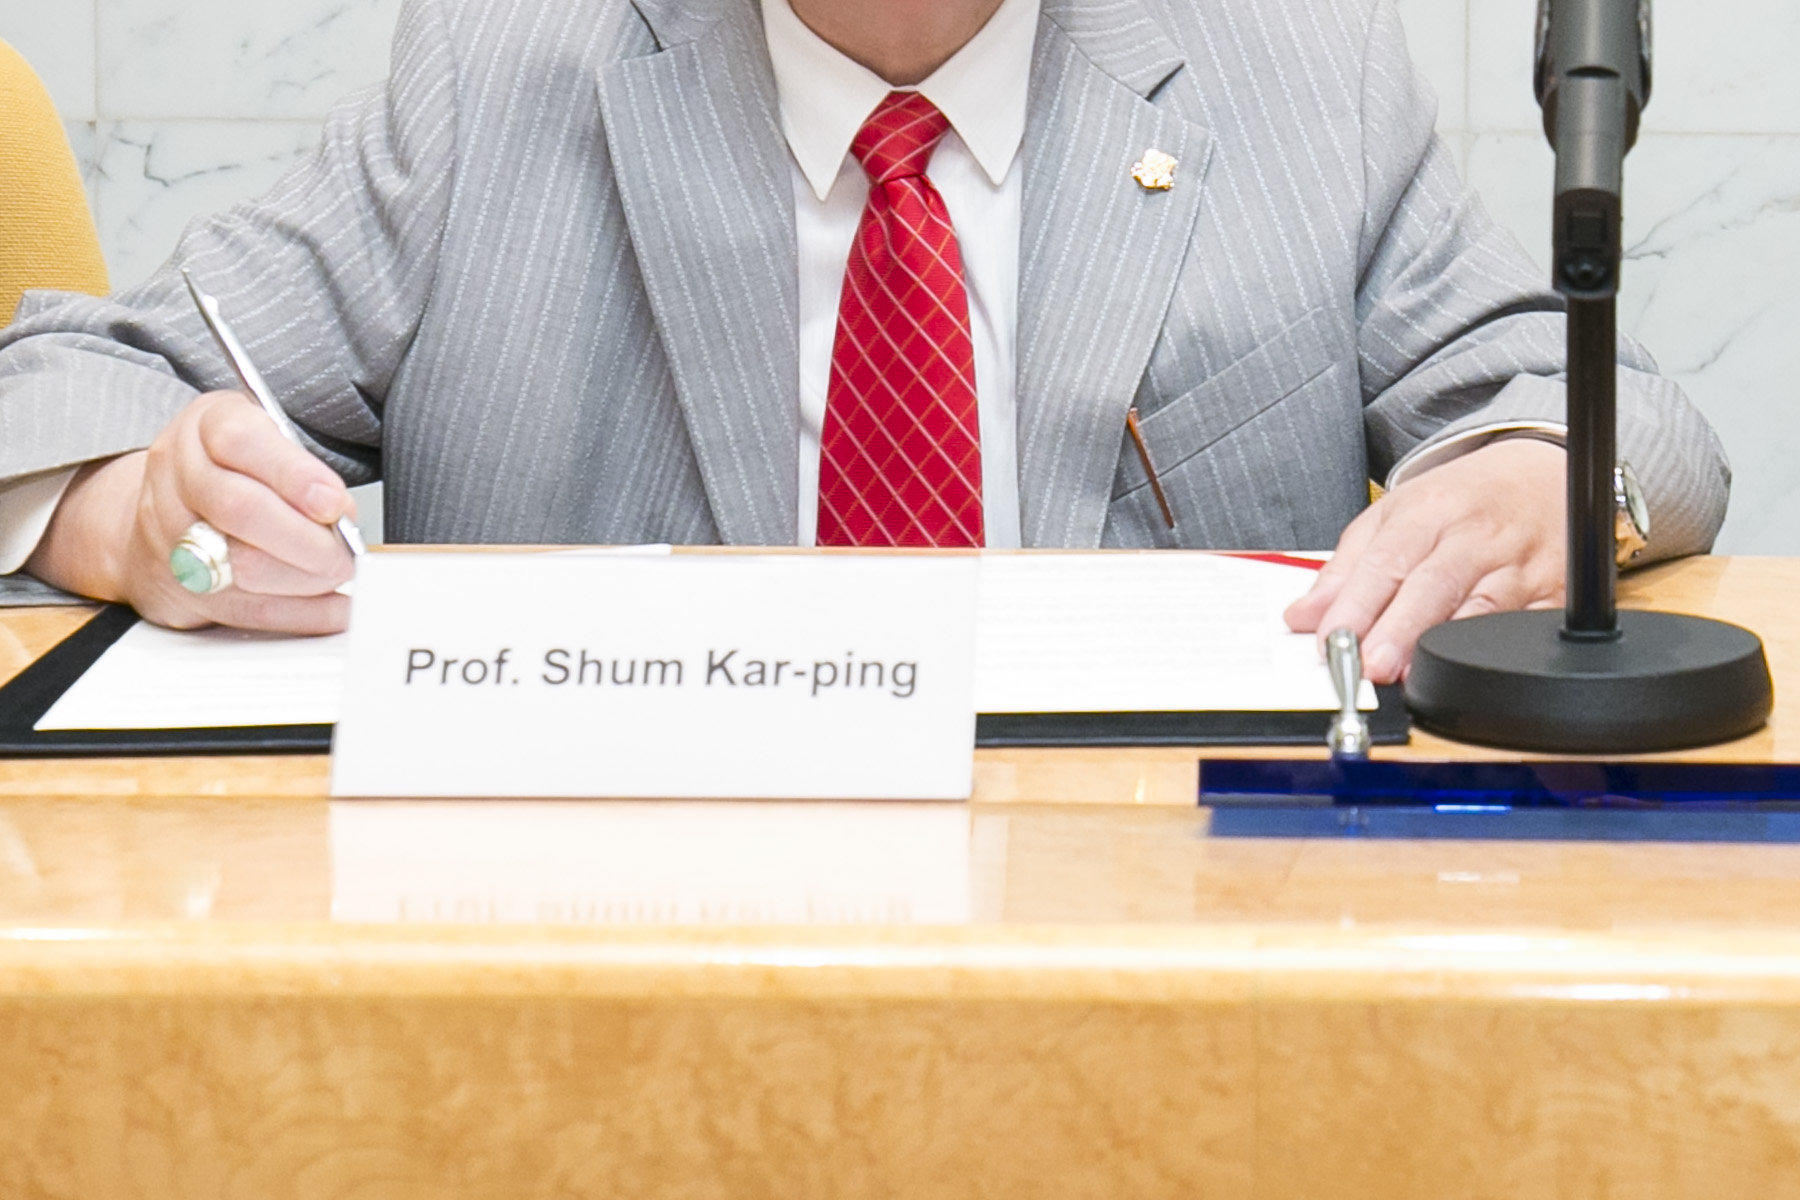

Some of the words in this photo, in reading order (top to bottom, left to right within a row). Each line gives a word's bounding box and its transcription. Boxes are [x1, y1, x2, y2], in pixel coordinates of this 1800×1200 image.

[404, 647, 520, 687] Prof.
[541, 647, 684, 687] Shum
[704, 648, 919, 699] Kar-ping
